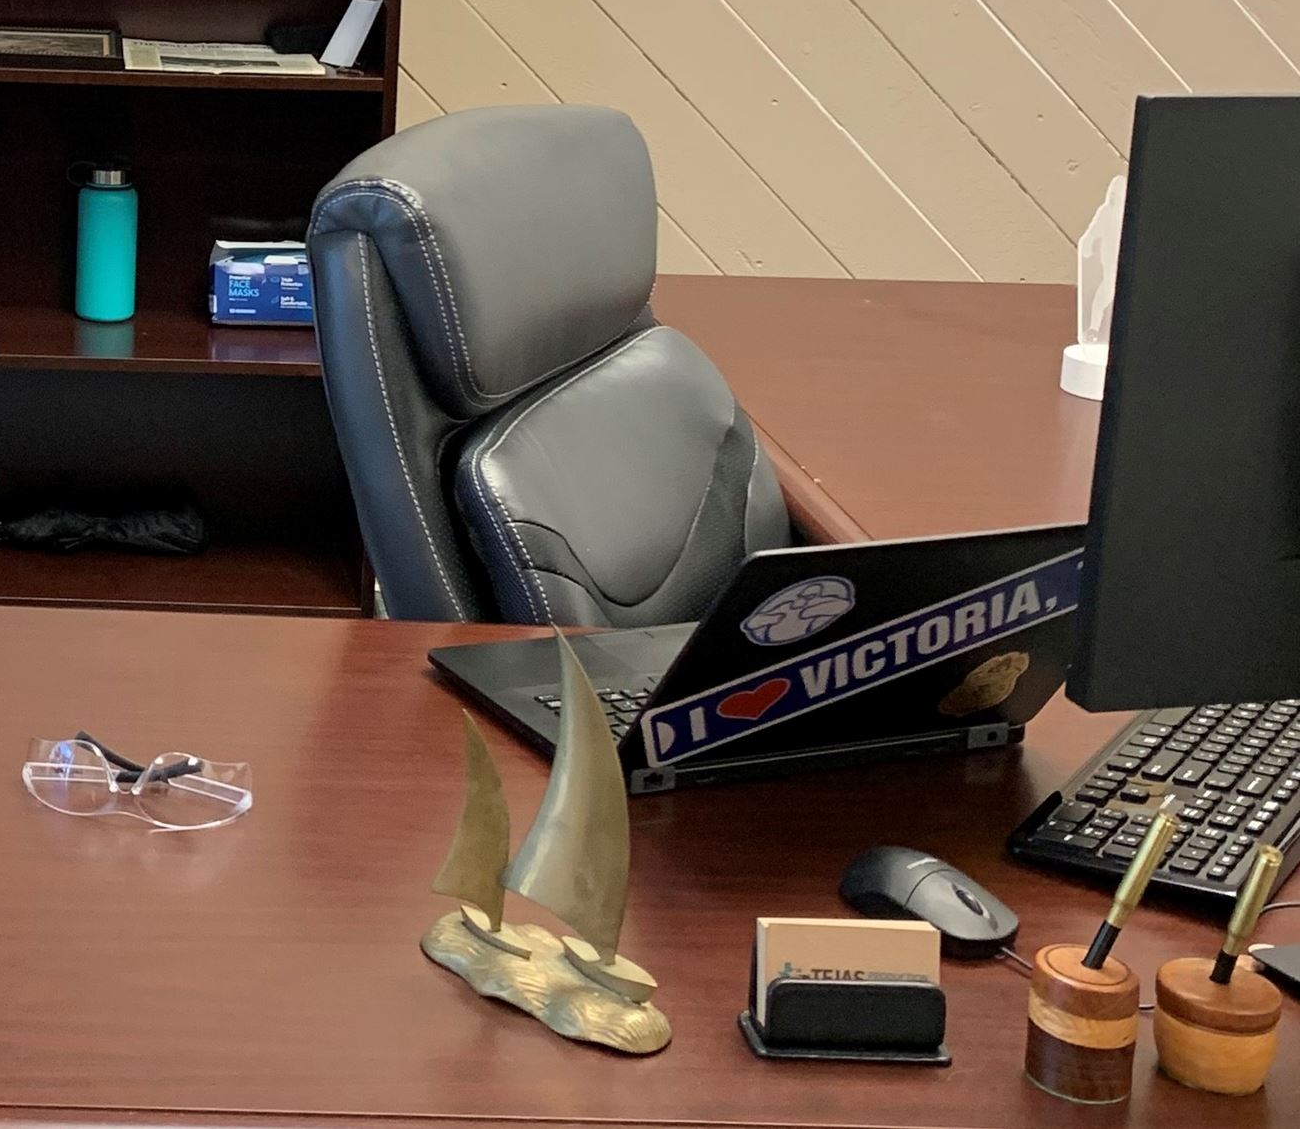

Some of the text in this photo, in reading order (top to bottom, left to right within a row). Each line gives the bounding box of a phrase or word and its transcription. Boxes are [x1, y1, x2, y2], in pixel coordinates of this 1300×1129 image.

[229, 280, 250, 288] FACE
[228, 288, 260, 297] MASKS
[688, 580, 1058, 742] I VICTORIA,
[811, 968, 865, 981] TEJAS
